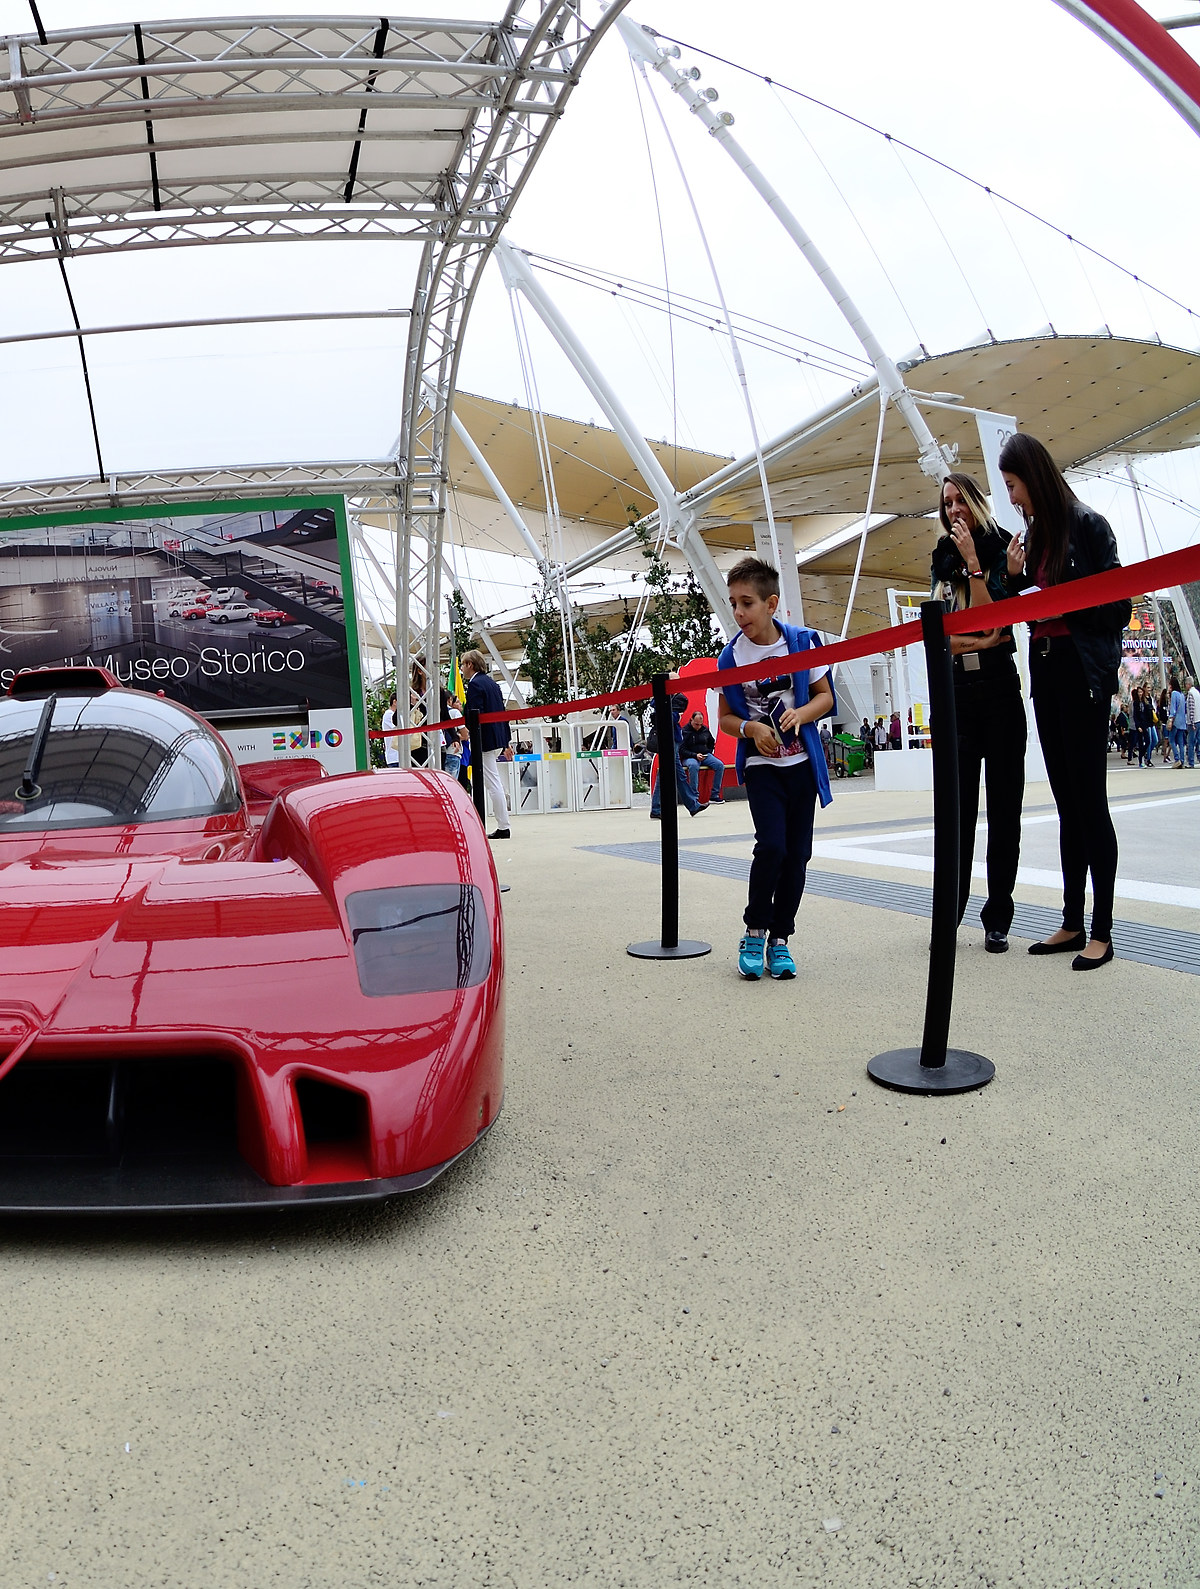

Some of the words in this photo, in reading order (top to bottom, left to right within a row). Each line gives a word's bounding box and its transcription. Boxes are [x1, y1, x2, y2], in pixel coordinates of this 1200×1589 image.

[200, 645, 305, 677] Storico
[237, 744, 257, 752] WITH
[272, 728, 344, 751] EXPO
